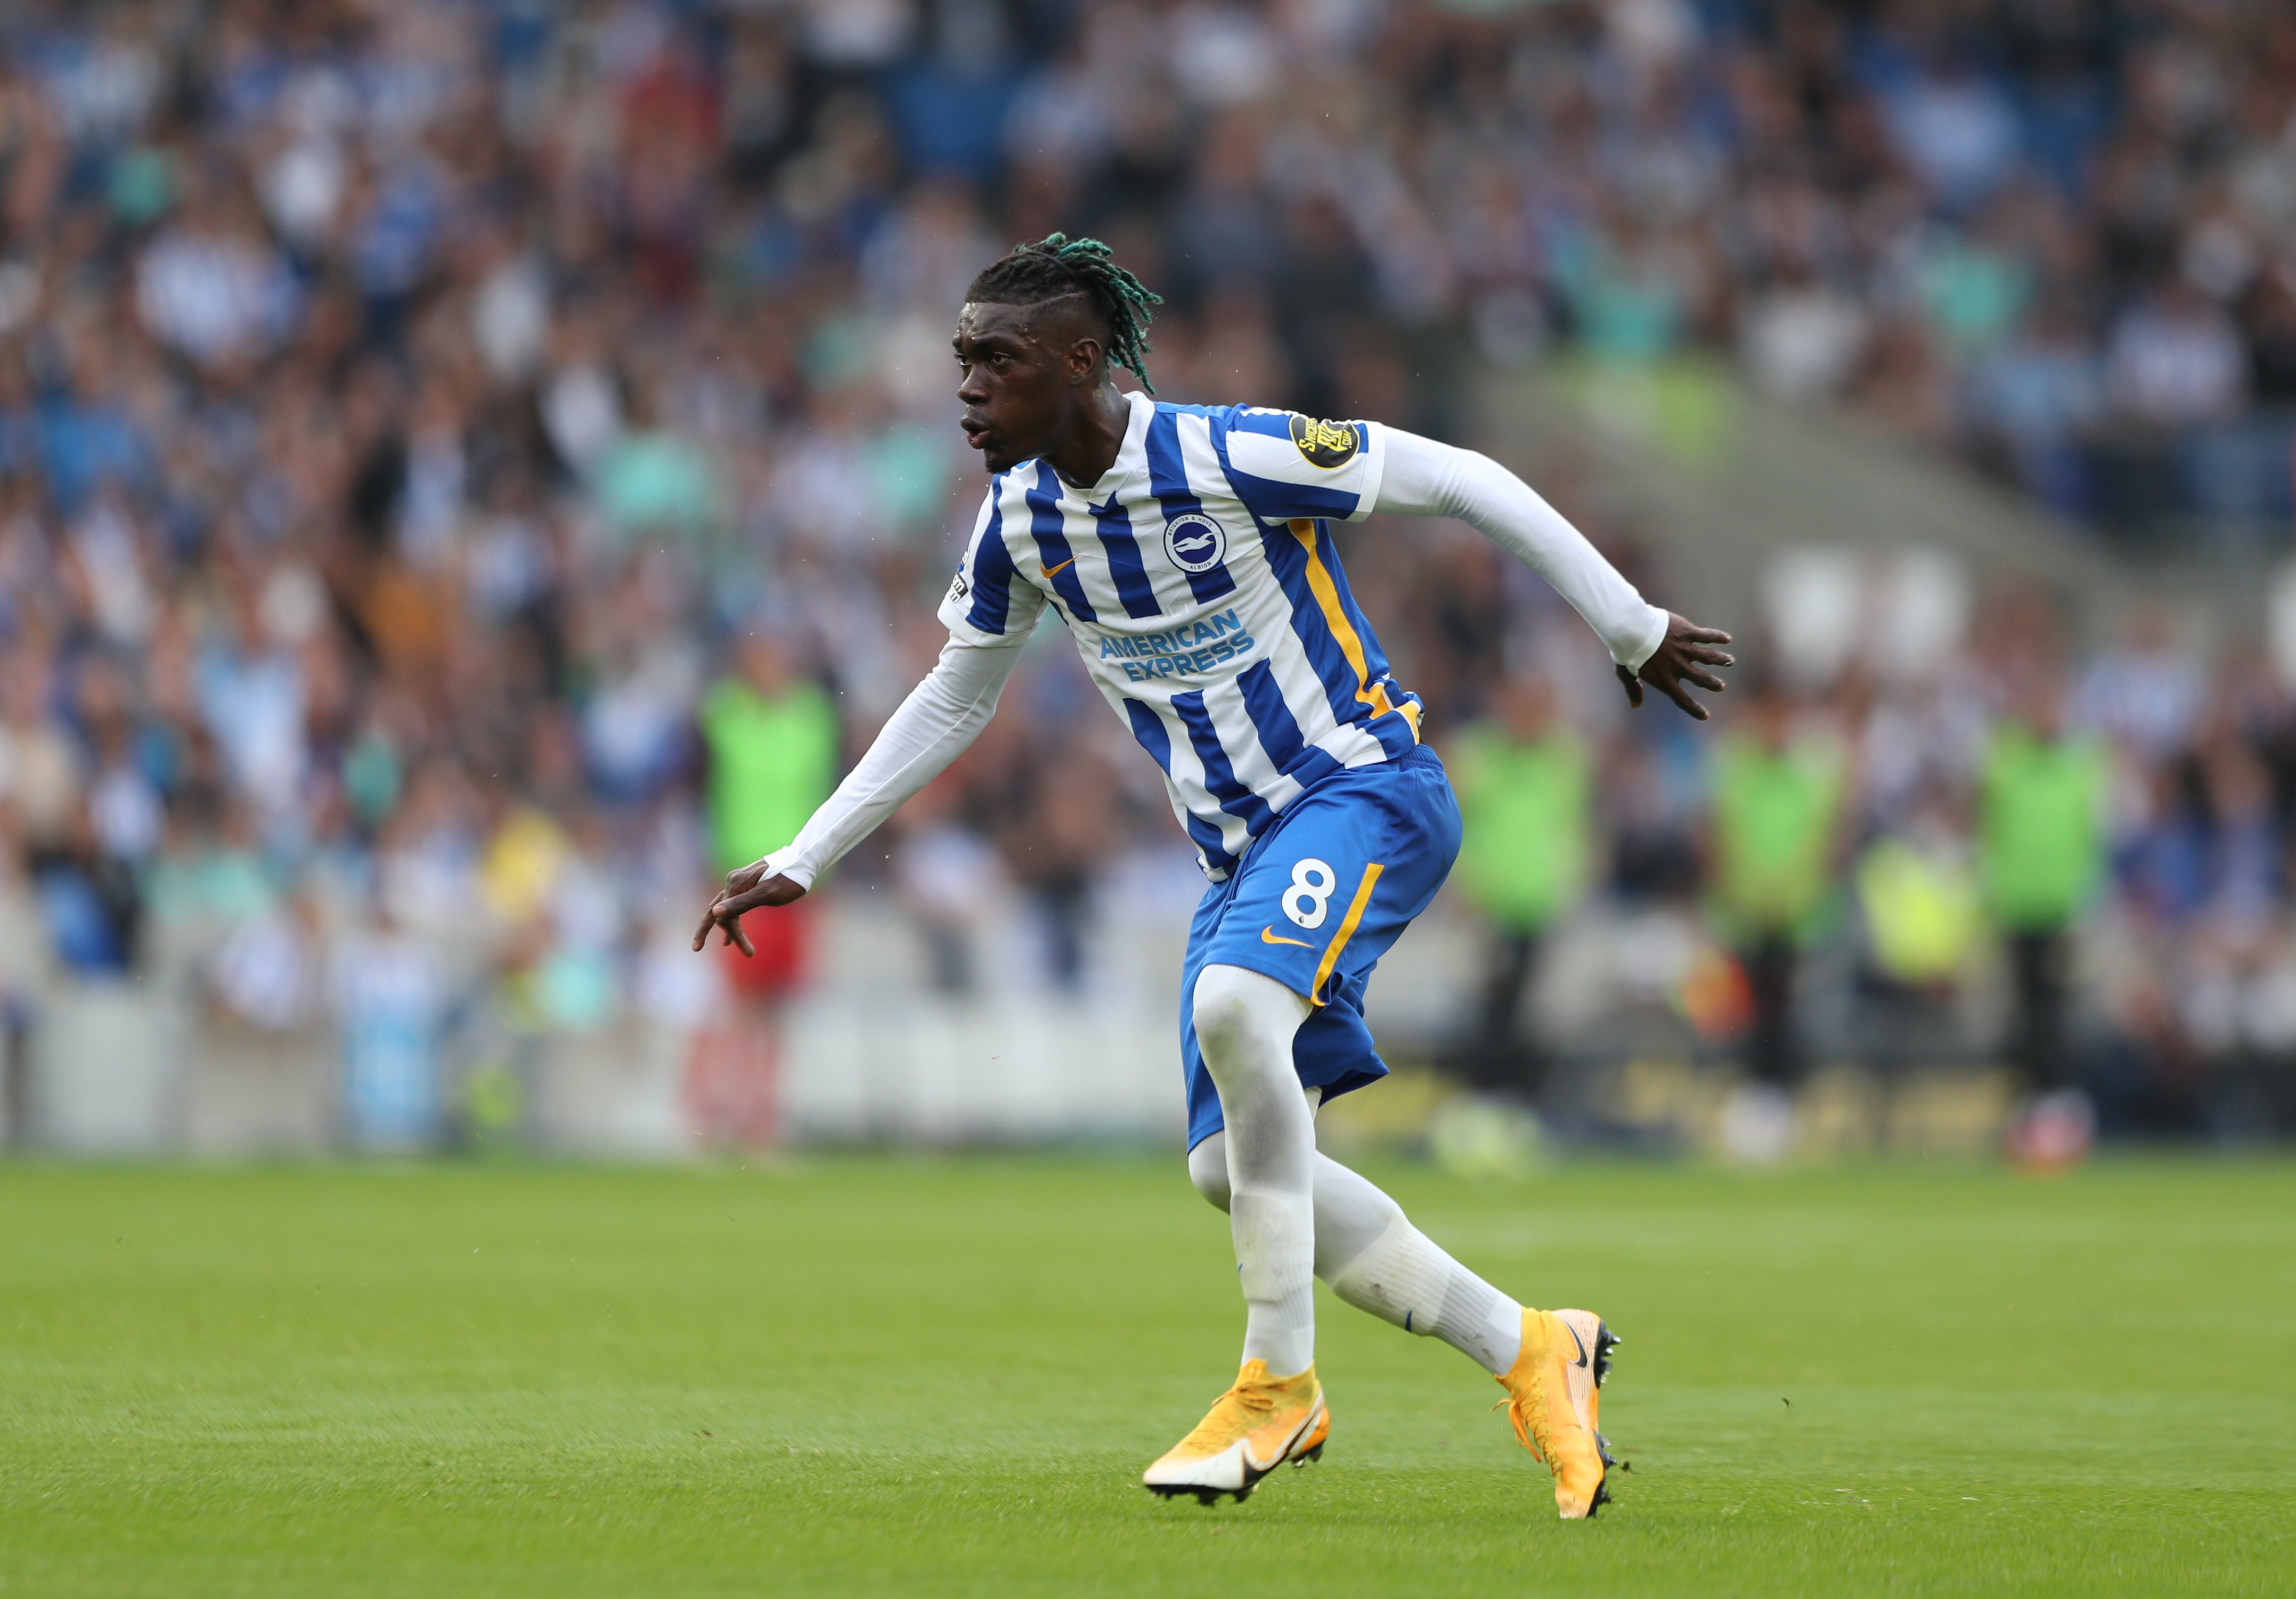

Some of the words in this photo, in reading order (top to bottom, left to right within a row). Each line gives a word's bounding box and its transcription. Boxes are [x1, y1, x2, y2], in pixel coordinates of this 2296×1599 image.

[1168, 516, 1189, 536] BRIGHTON
[1198, 517, 1213, 527] HOVE
[1190, 561, 1212, 570] ALBION
[1100, 608, 1241, 659] AMERICAN
[1121, 629, 1255, 682] EXPRESS
[1281, 858, 1337, 930] 8
